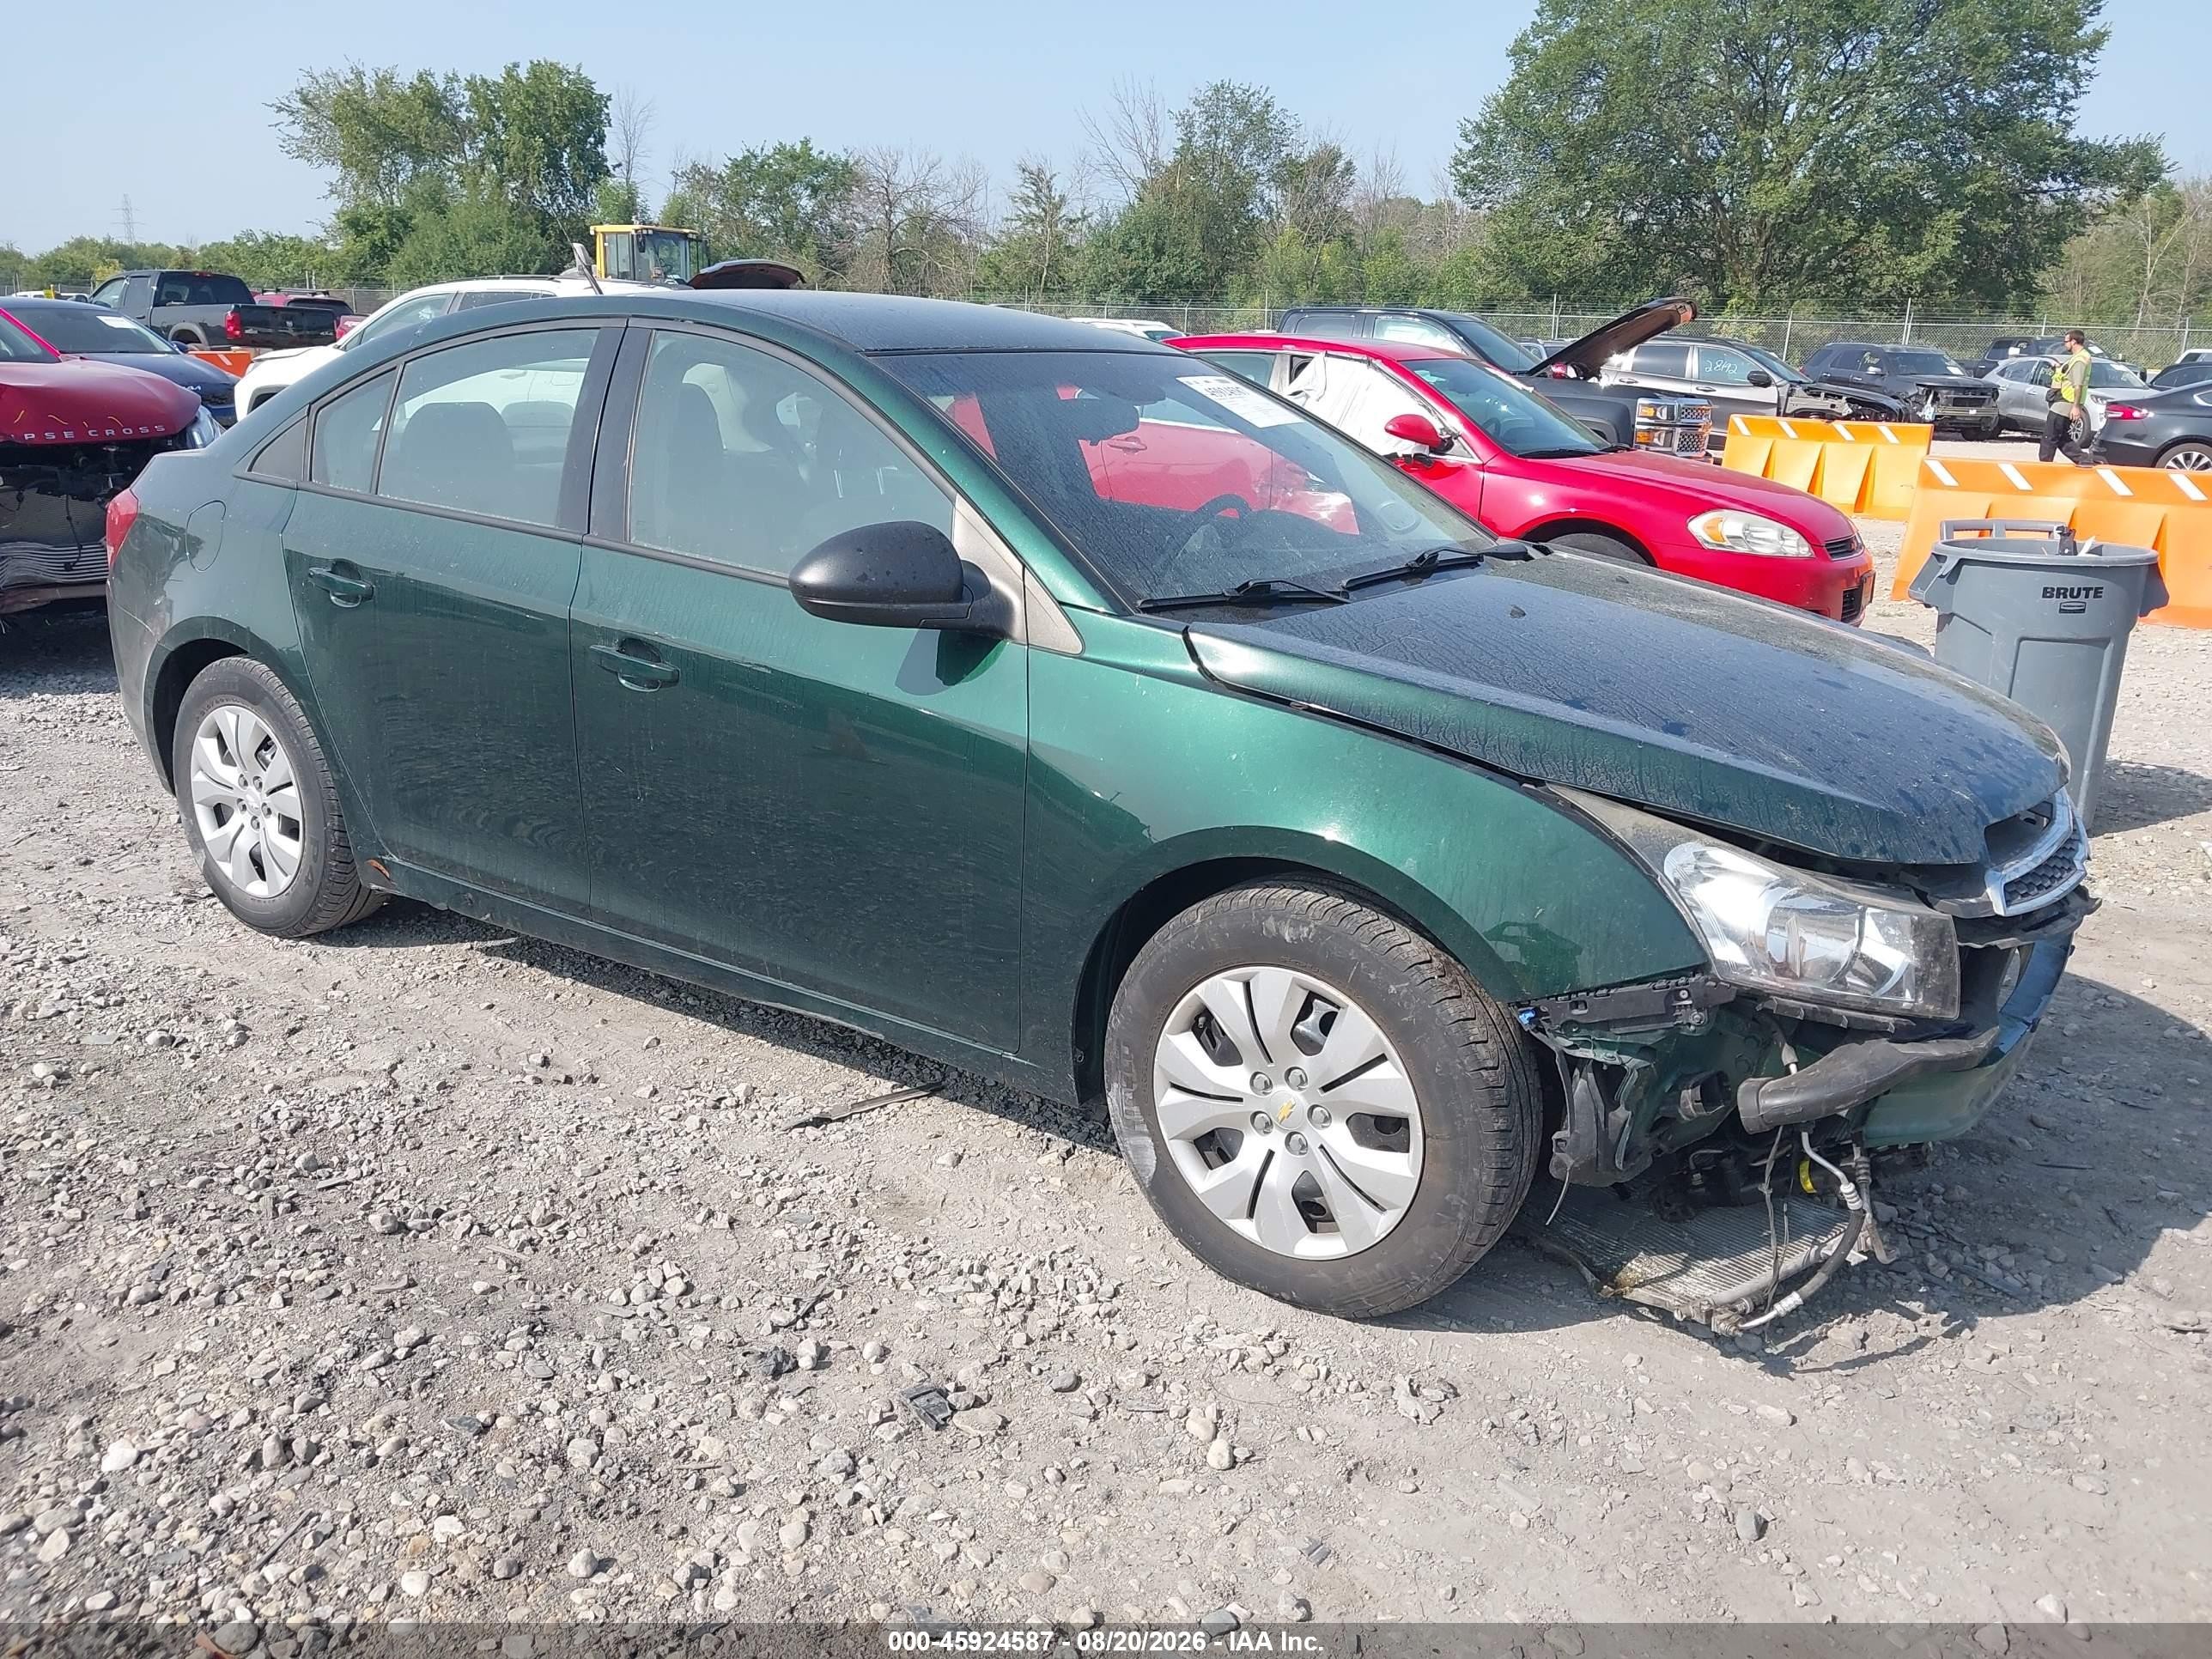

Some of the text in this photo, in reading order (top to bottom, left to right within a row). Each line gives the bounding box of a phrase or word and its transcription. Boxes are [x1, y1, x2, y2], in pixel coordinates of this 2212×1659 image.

[10, 425, 166, 440] PSE CROSS
[2041, 586, 2104, 599] BRUTE
